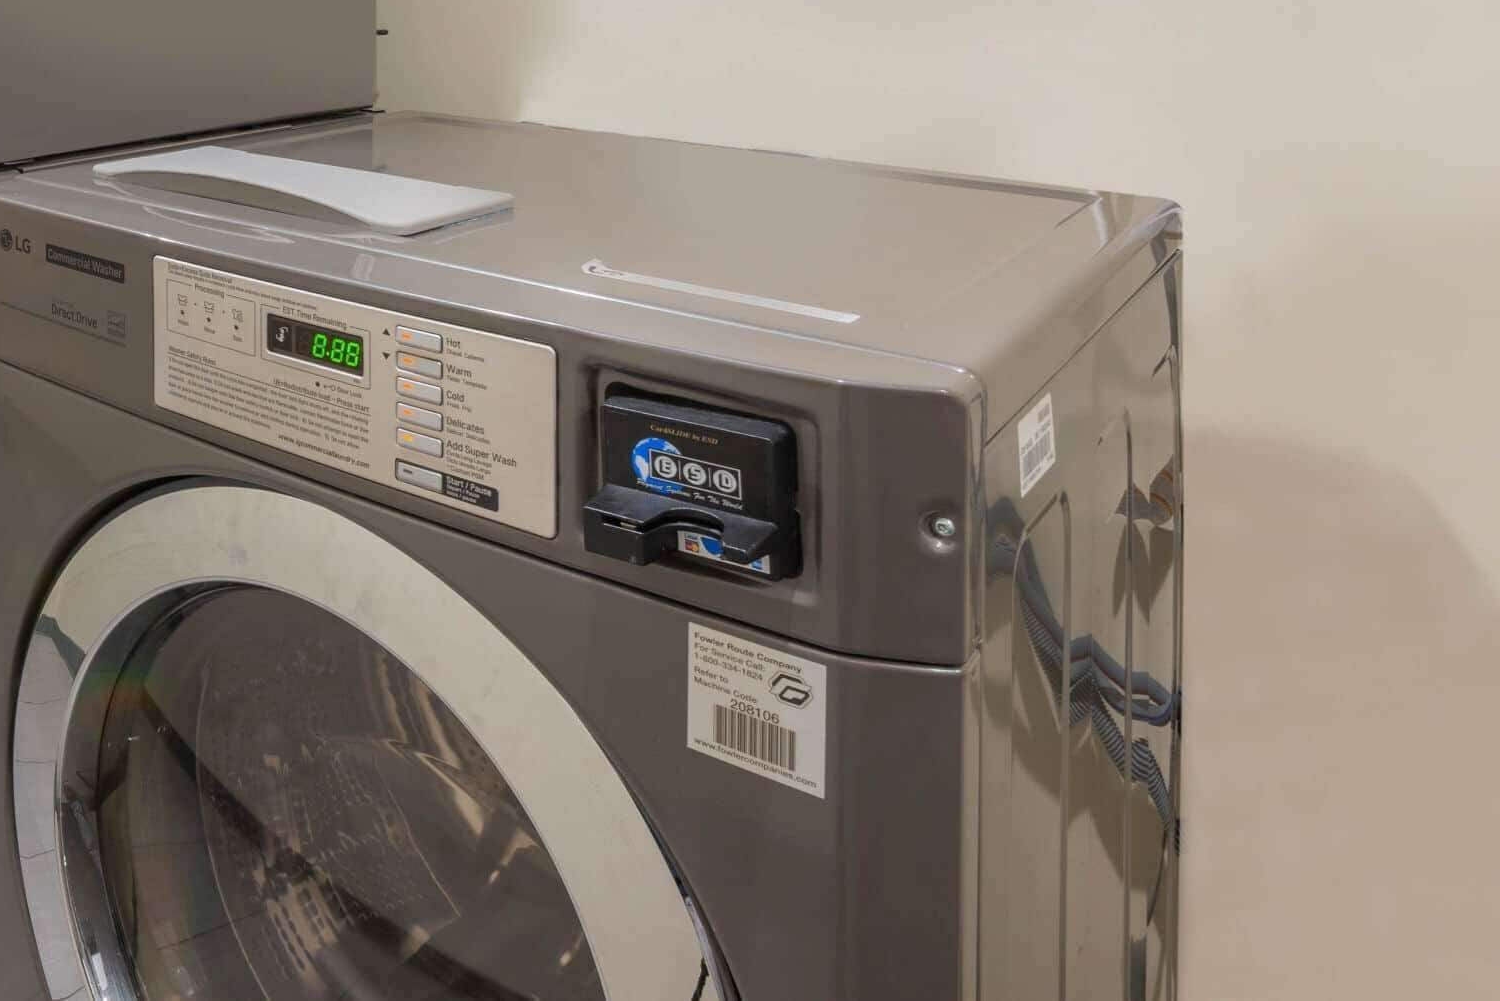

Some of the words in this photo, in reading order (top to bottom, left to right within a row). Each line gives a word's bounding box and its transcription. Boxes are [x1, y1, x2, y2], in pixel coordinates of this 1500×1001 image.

[14, 235, 32, 254] LG
[47, 248, 91, 271] Commercial
[91, 258, 123, 279] Washer
[51, 302, 75, 321] Direct
[76, 310, 99, 329] Drive
[296, 309, 312, 320] Time
[312, 313, 349, 331] Remaining
[446, 337, 461, 349] Hot
[445, 363, 473, 378] Warm
[446, 389, 465, 403] Cold
[354, 403, 371, 413] start
[446, 415, 485, 435] Delicates
[446, 439, 464, 452] Add
[464, 444, 491, 460] Super
[491, 452, 517, 468] Wash
[653, 455, 738, 494] ESD
[446, 477, 464, 488] Start
[469, 483, 493, 497] Pause
[692, 492, 706, 501] For
[707, 495, 720, 505] The
[721, 498, 744, 511] World
[693, 631, 725, 647] Fowler
[726, 642, 755, 658] Route
[755, 652, 803, 674] Company
[693, 641, 709, 651] For
[710, 646, 744, 665] Service
[744, 658, 766, 672] Call:
[693, 652, 764, 681] 1-800-334-1824
[693, 665, 717, 679] Refer
[718, 674, 730, 684] to
[693, 675, 732, 696] Machine
[729, 698, 781, 725] 208106
[693, 737, 818, 789] www.fowlercompanies.com
